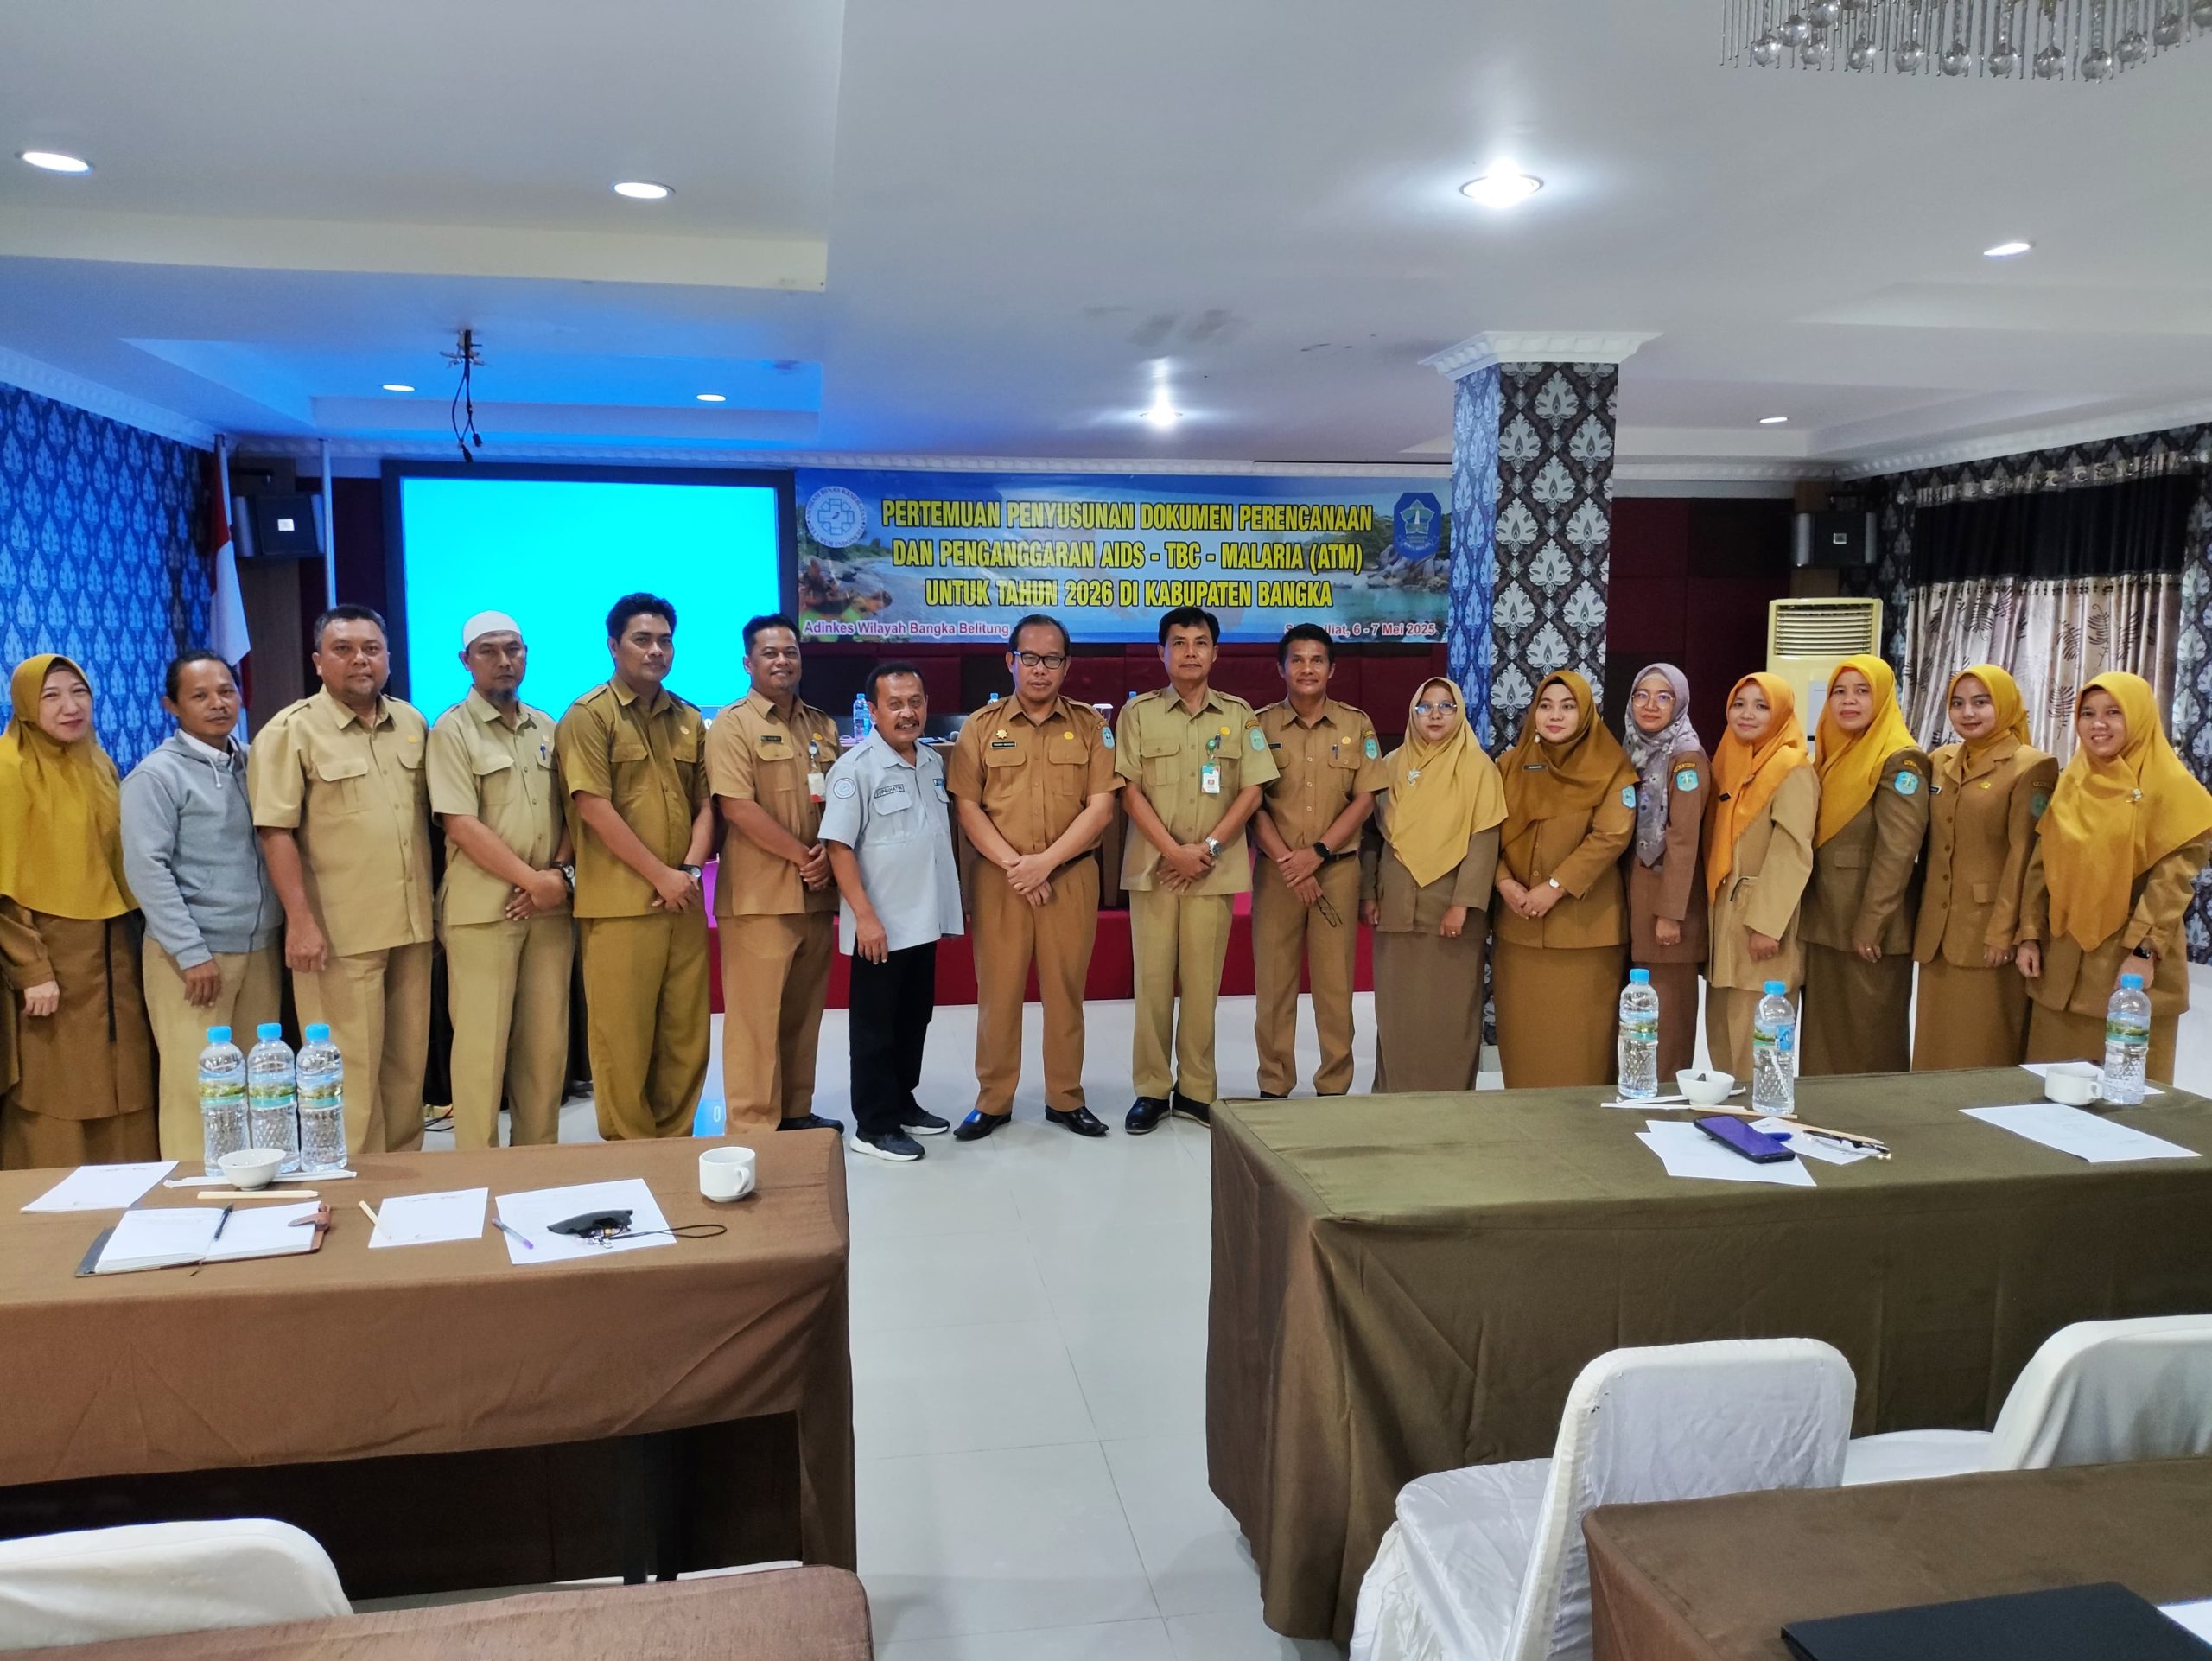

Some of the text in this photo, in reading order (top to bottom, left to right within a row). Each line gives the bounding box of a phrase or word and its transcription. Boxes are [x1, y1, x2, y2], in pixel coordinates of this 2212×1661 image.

[882, 499, 1373, 531] PERTEMUAN PENYUSUNAN DOKUMEN PERENCANAAN
[893, 538, 933, 567] DAN
[939, 539, 1095, 568] PENGANGGARAN
[1100, 541, 1146, 568] AIDS
[1150, 553, 1160, 562] -
[1164, 541, 1201, 569] TBC
[1221, 542, 1304, 570] MALARIA
[1309, 542, 1363, 576] (ATM)
[925, 578, 1333, 608] UNTUK TAHUN 2026 DI KABUPATEN BANGKA
[804, 621, 1009, 638] Adinkes Wilayah Bangka Belitung
[1352, 622, 1361, 635] 6
[1371, 622, 1380, 635] 7
[1382, 623, 1404, 635] Mei
[1406, 623, 1436, 635] 2025
